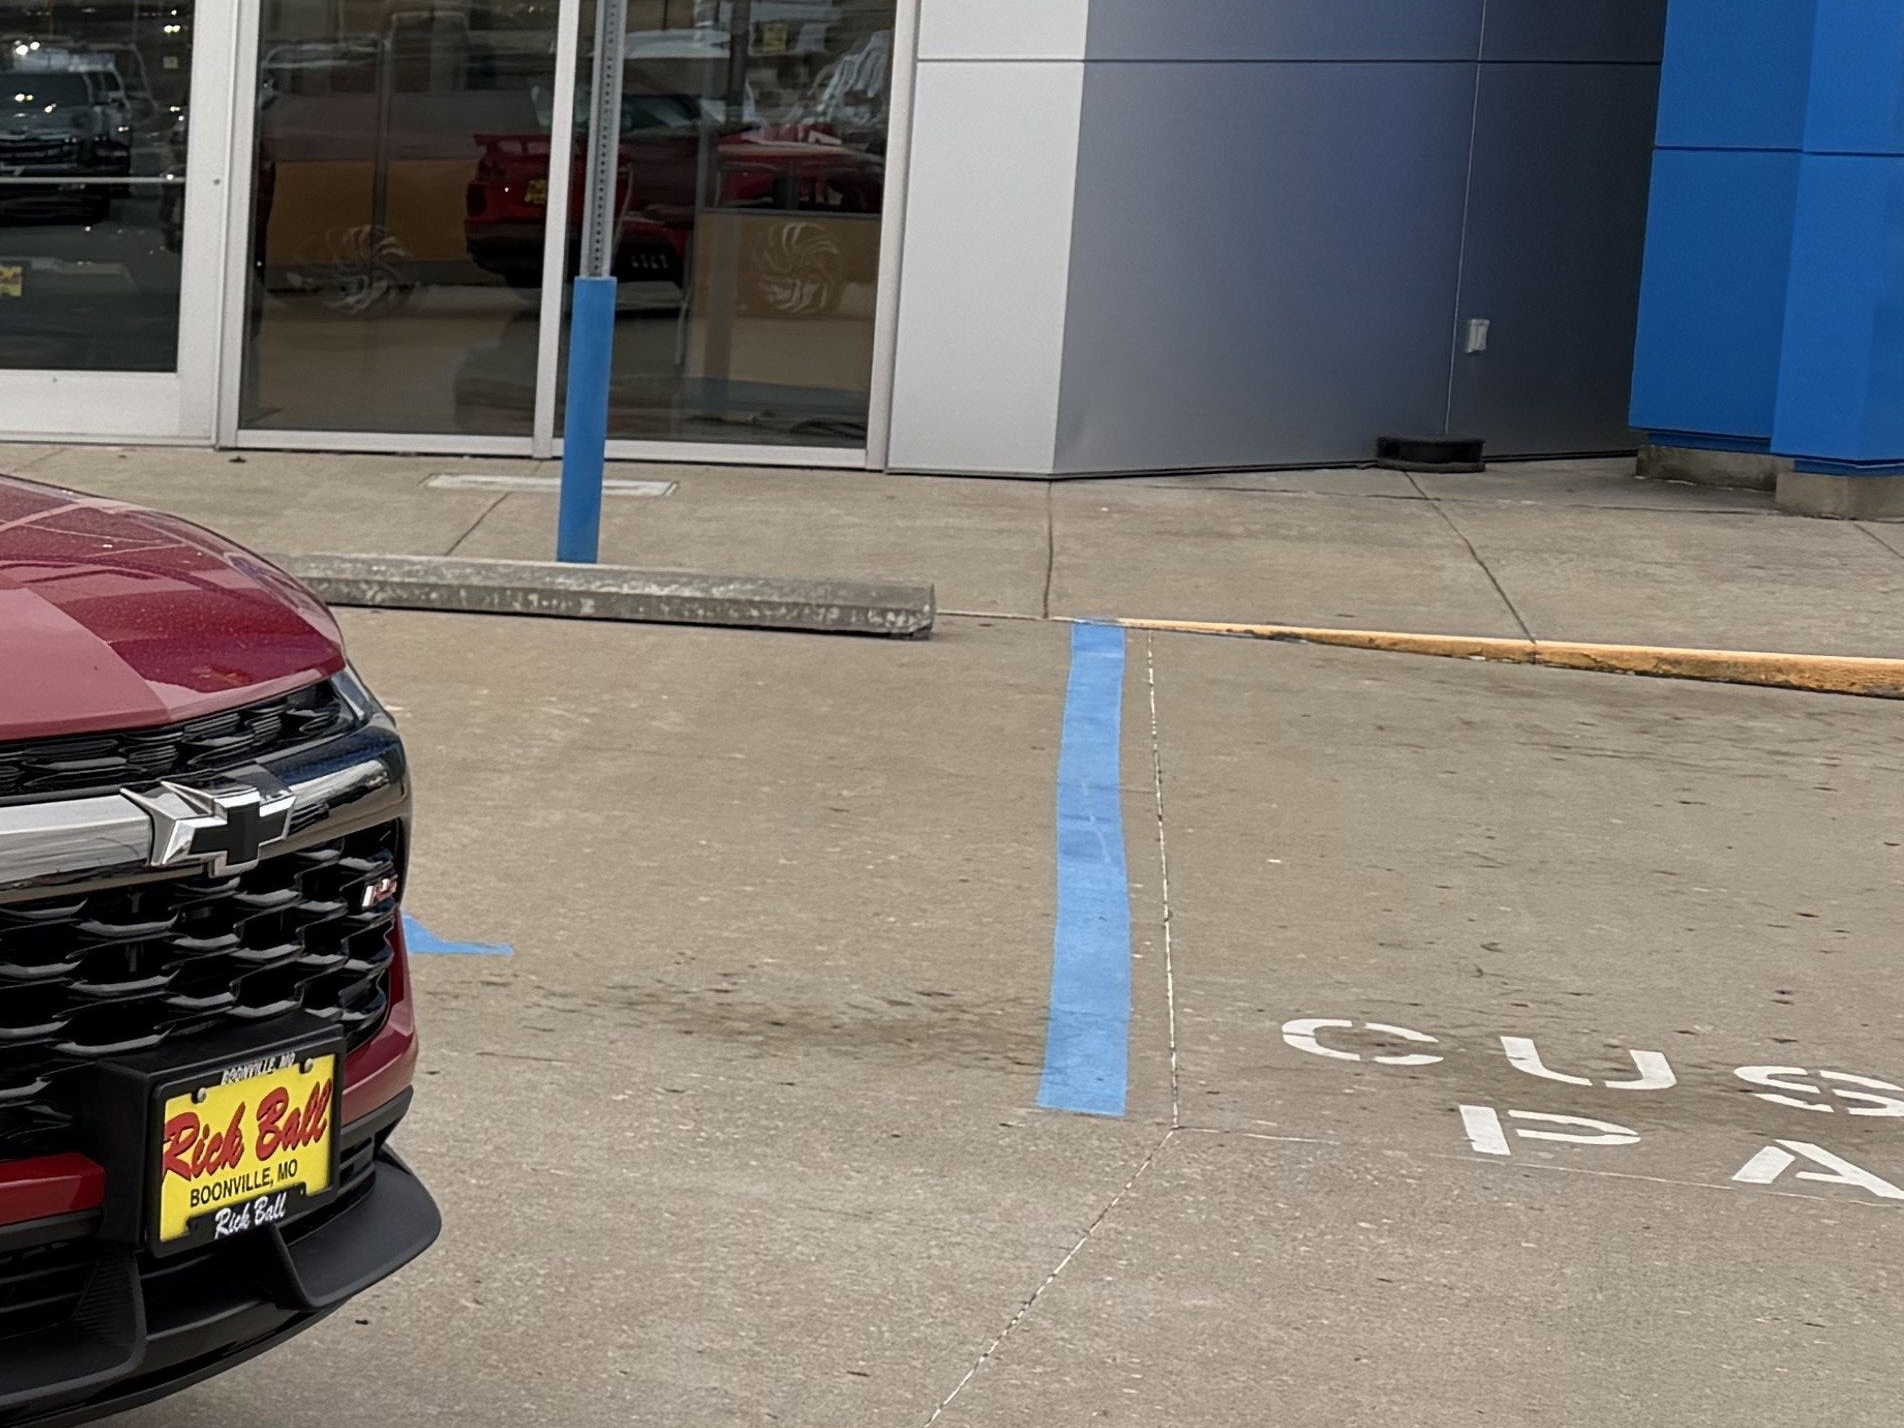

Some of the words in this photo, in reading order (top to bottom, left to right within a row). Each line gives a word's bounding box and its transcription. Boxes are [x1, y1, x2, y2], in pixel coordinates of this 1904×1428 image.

[1281, 1019, 1904, 1117] CUS
[162, 1101, 246, 1182] Rick
[256, 1077, 333, 1162] Ball
[1459, 1104, 1904, 1200] PA
[190, 1166, 273, 1208] BOONVILLE,
[277, 1159, 298, 1180] MO
[214, 1208, 251, 1240] Rick
[253, 1192, 287, 1226] Ball
